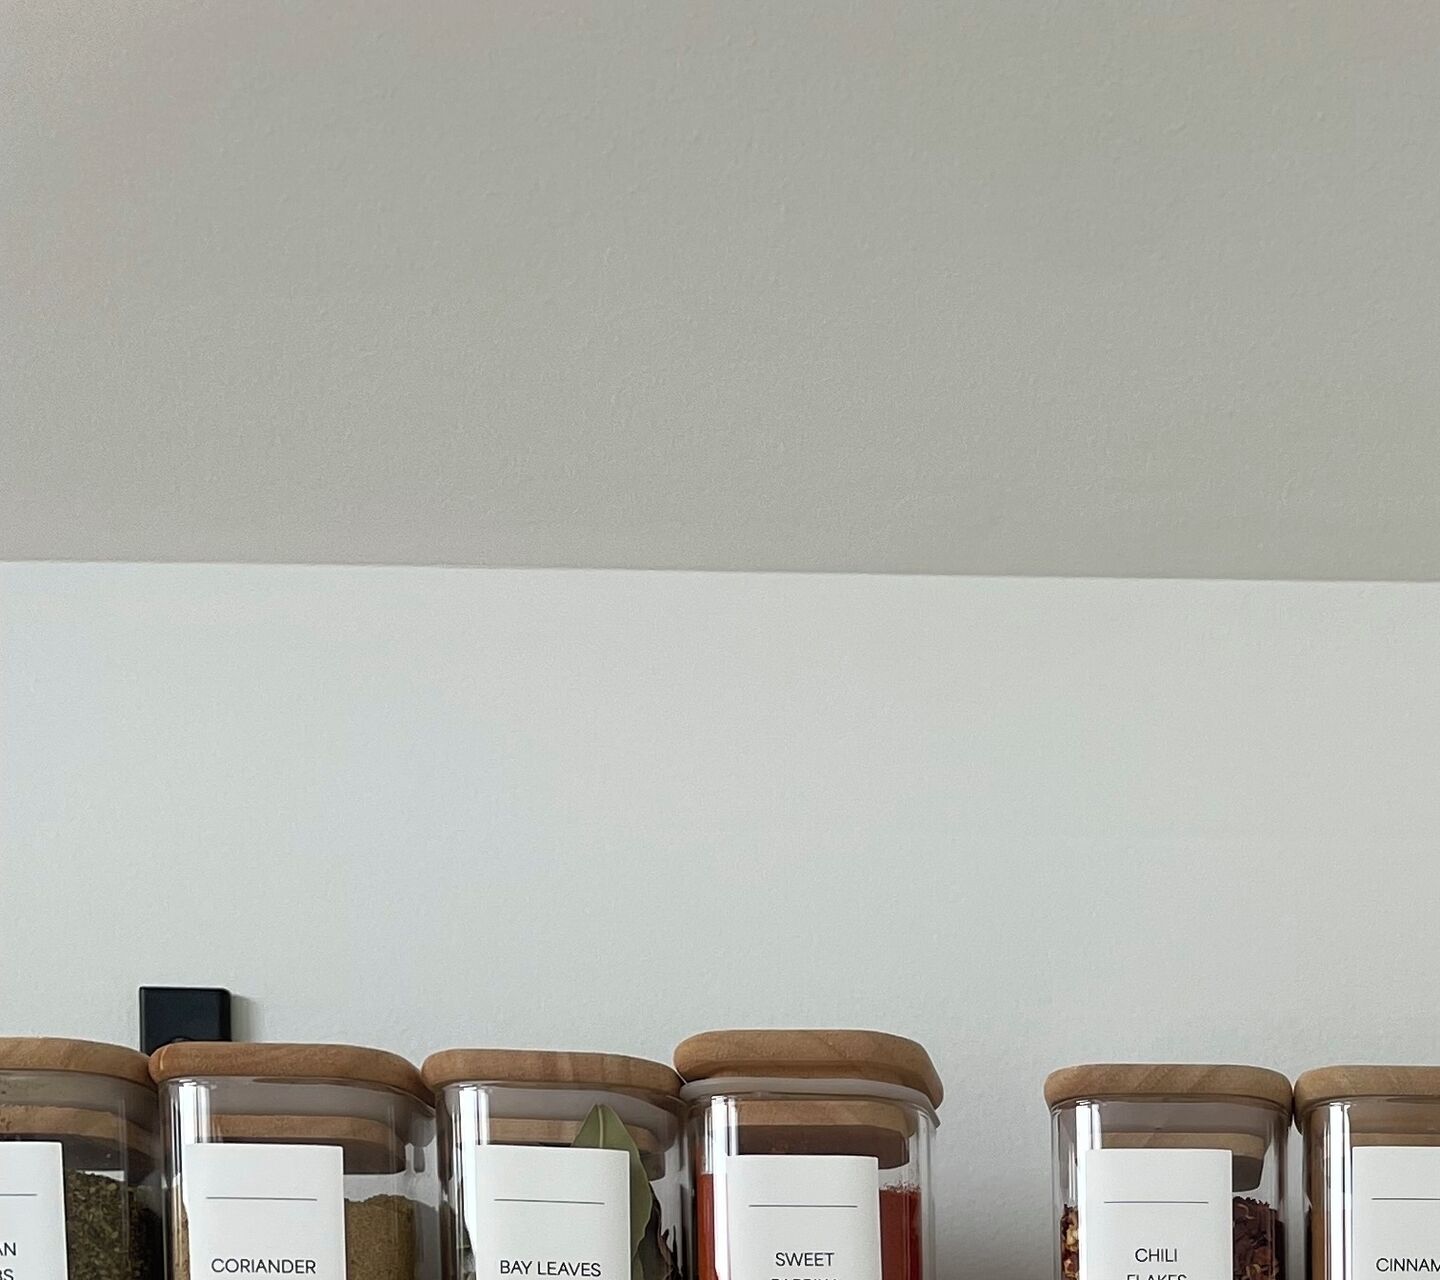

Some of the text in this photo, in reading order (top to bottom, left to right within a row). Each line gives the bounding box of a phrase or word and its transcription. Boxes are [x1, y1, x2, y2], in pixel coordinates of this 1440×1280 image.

[775, 1251, 835, 1267] SWEET
[1134, 1247, 1178, 1263] CHILI
[210, 1258, 317, 1275] CORIANDER
[499, 1259, 602, 1278] BAY LEAVES
